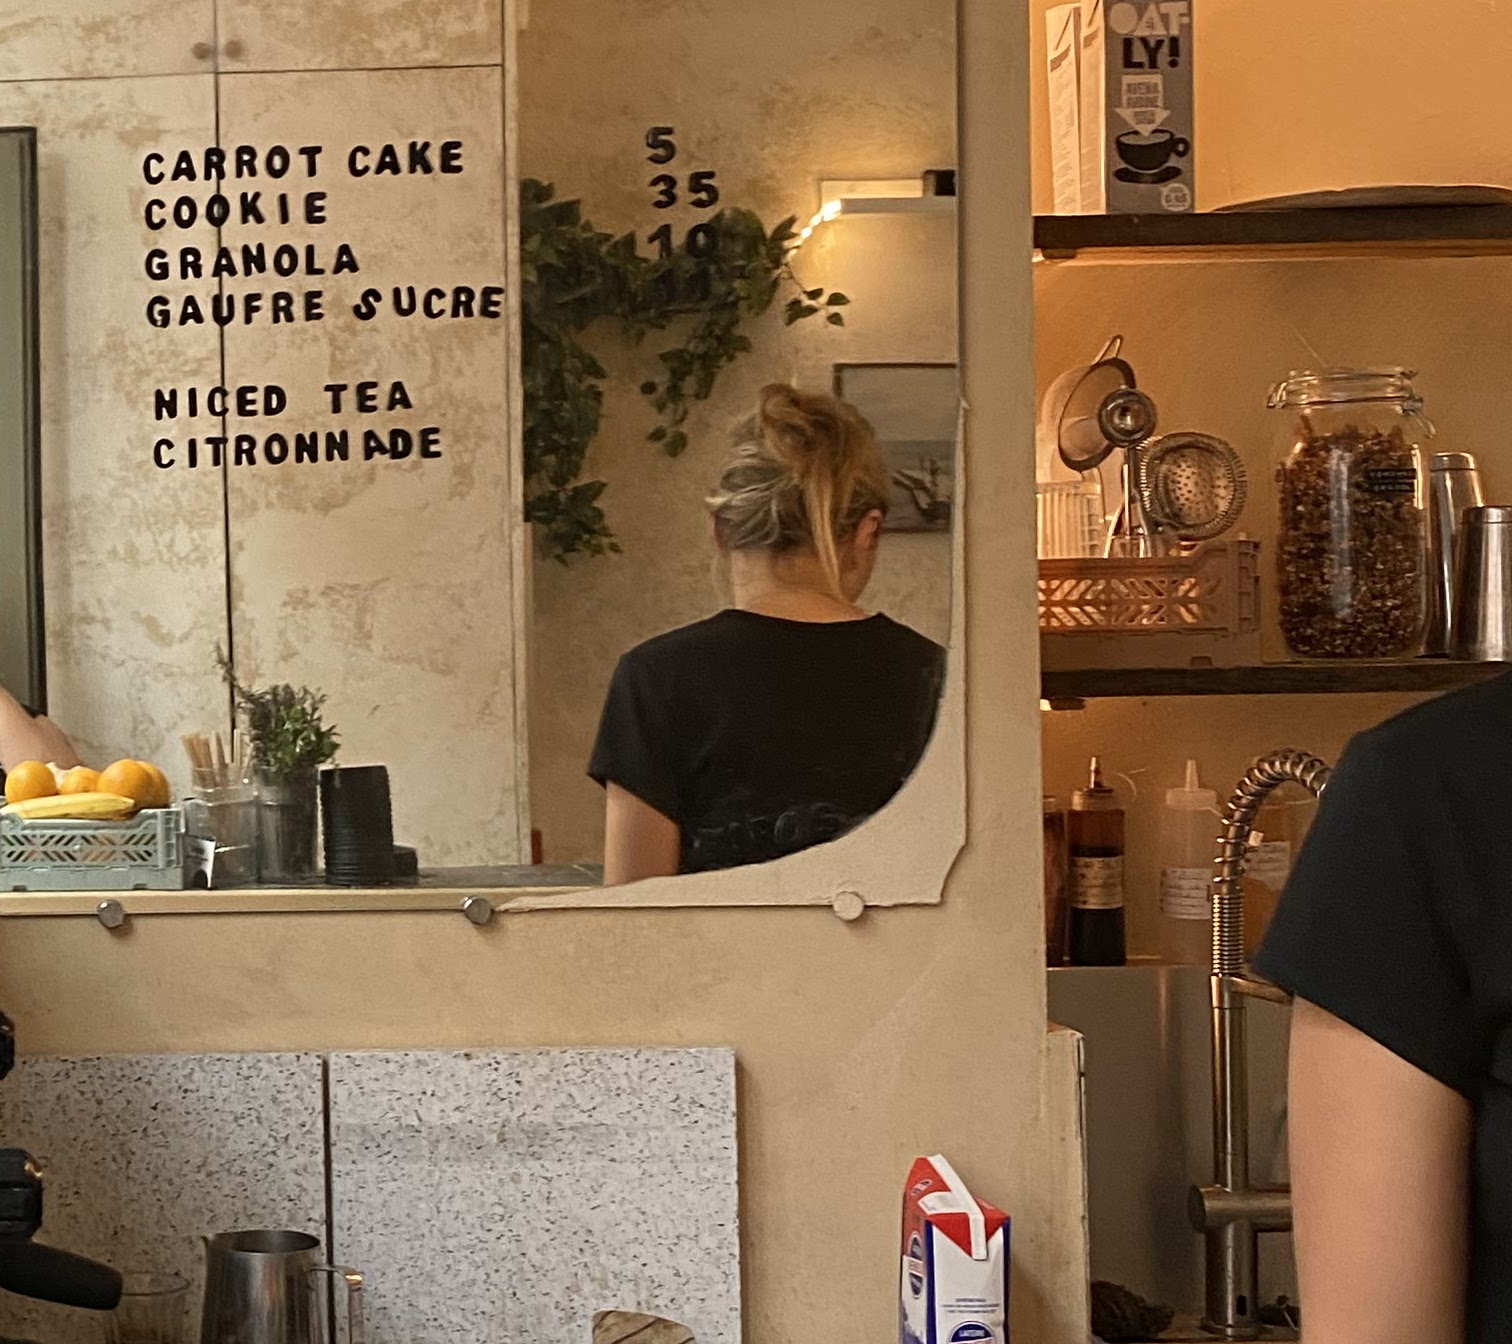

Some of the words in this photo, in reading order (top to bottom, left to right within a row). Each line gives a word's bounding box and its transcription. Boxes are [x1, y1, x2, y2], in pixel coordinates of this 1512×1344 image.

[1122, 35, 1180, 69] LY!
[142, 145, 323, 185] CARROT
[348, 141, 464, 178] CAKE
[646, 126, 677, 165] 5
[144, 192, 328, 230] COOKIE
[144, 244, 359, 282] GRANOLA
[146, 290, 324, 328] GAUFRE
[352, 286, 506, 322] SUCRE
[154, 385, 288, 421] NICED
[324, 382, 413, 415] TEA
[152, 427, 442, 469] CITRONNADE
